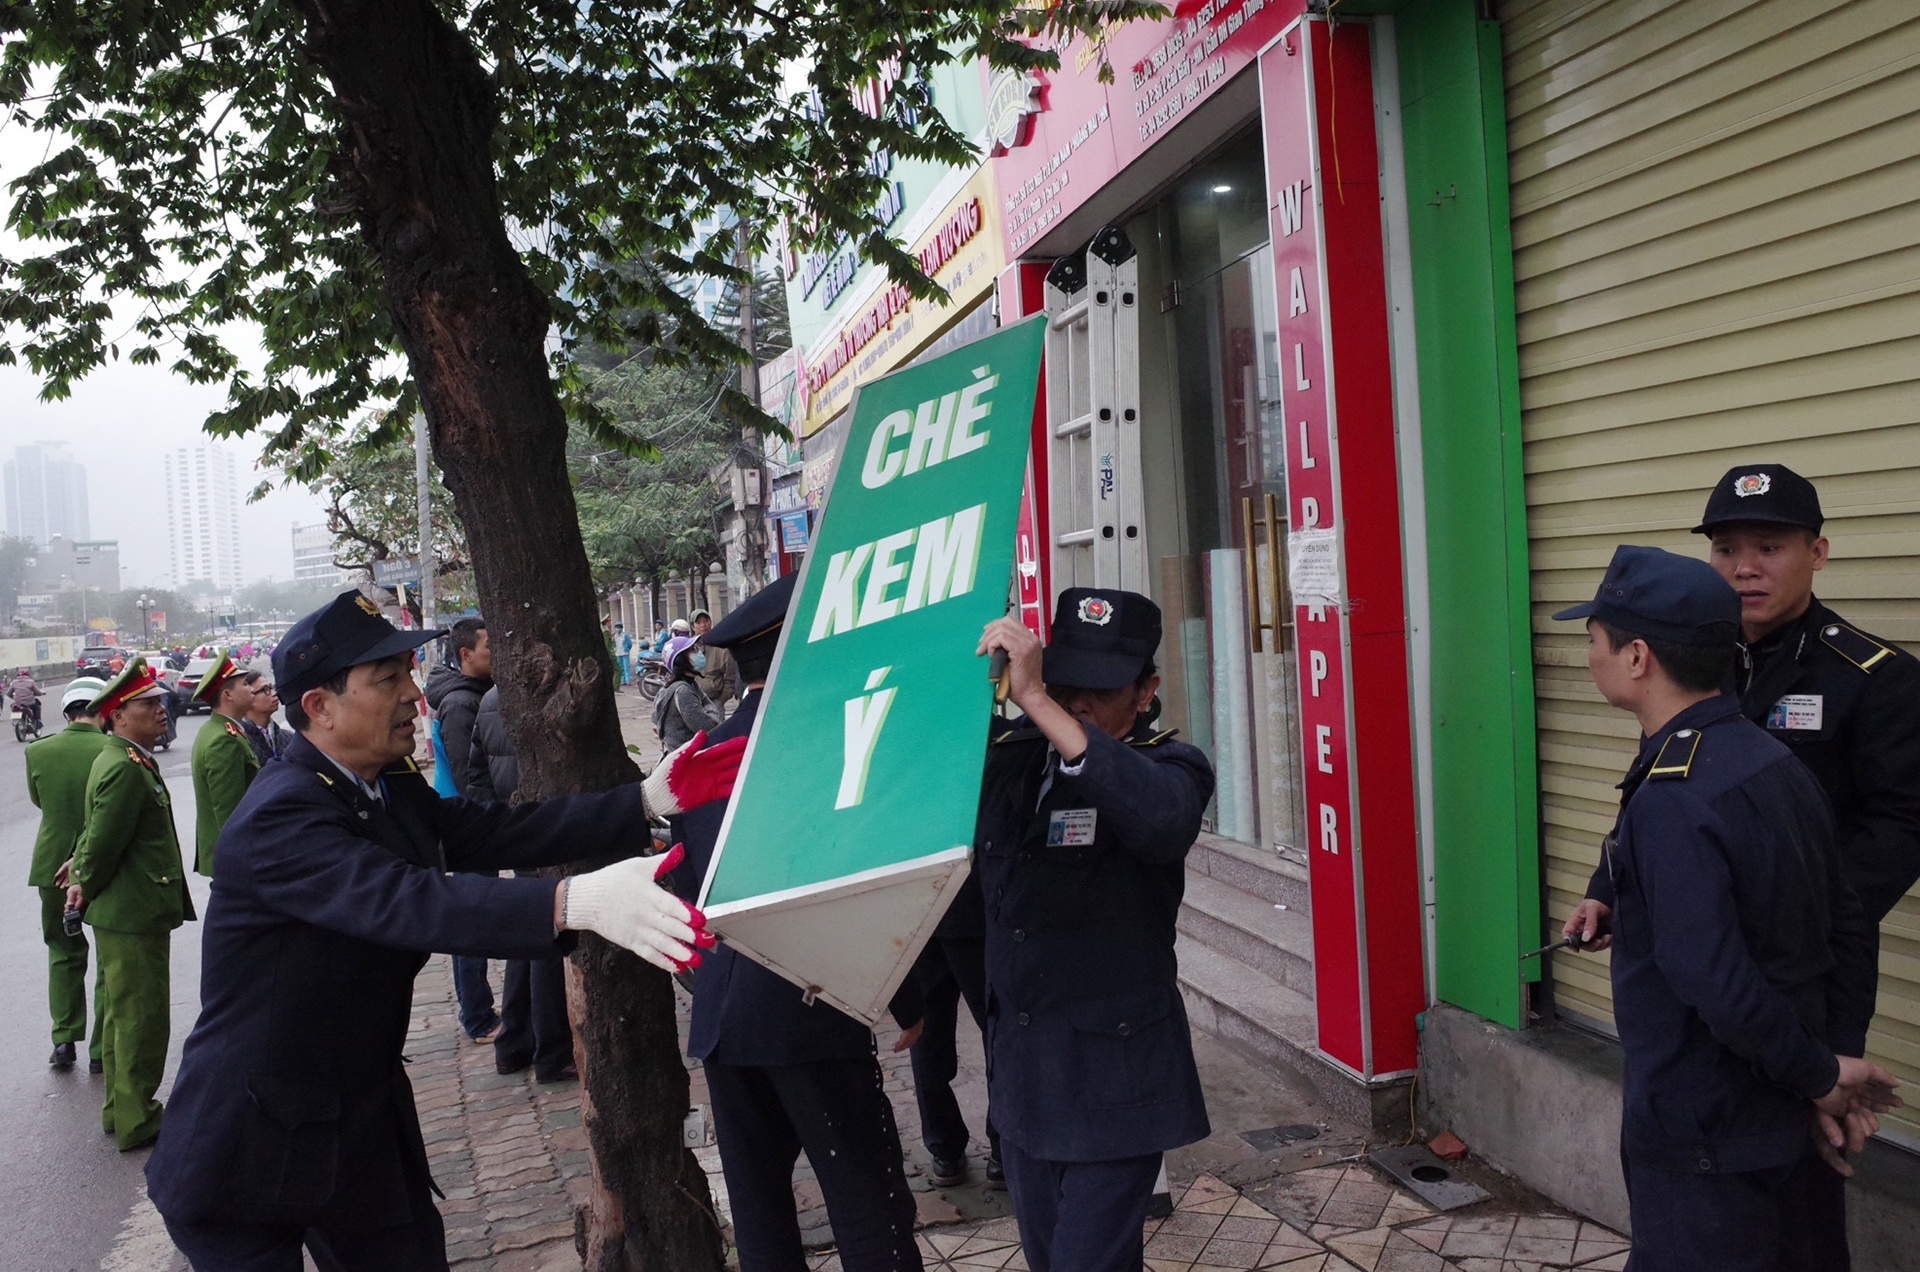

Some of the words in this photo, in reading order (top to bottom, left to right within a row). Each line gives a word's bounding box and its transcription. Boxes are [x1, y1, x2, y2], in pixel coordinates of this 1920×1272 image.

[987, 78, 1025, 133] SWEDEN
[939, 196, 981, 262] HƯƠNG
[862, 364, 998, 490] CHÈ
[1100, 468, 1113, 501] PAL
[404, 560, 411, 569] 3
[808, 503, 987, 644] KEM
[834, 666, 898, 811] Ý
